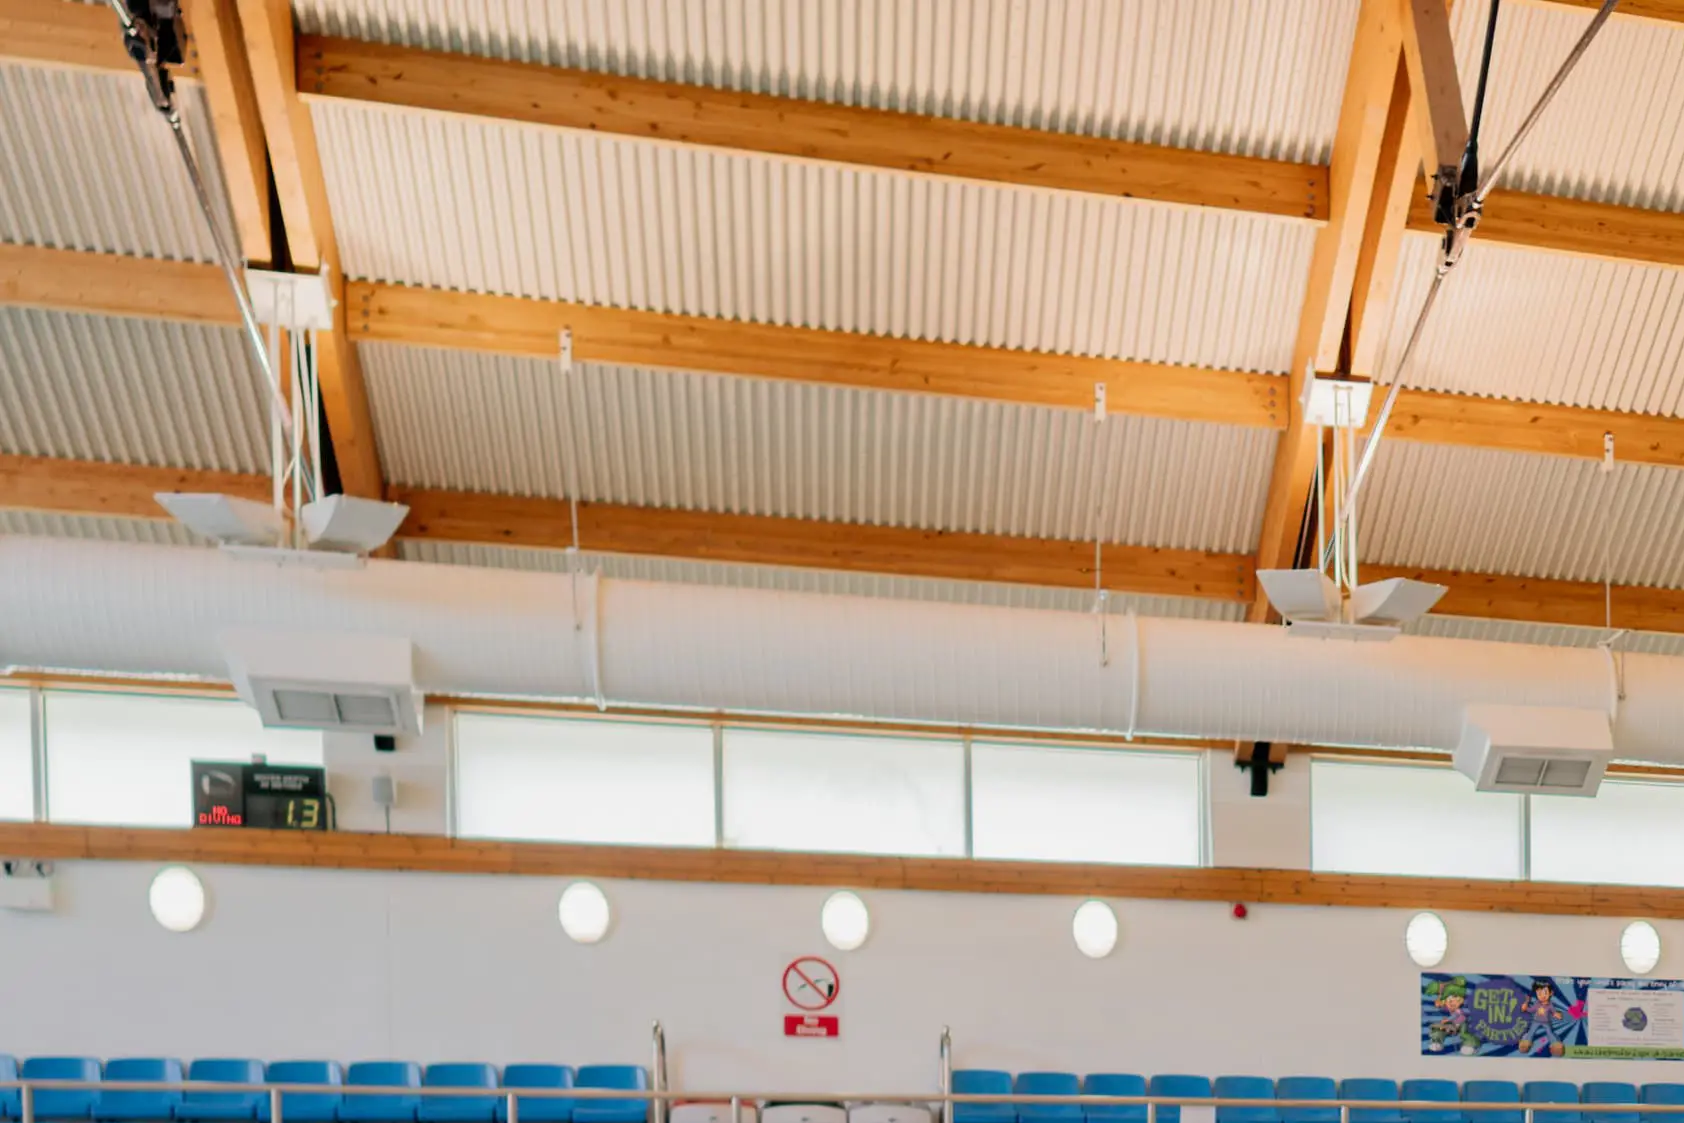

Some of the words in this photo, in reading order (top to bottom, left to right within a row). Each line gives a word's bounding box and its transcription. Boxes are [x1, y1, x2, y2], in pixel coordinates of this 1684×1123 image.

[212, 805, 228, 816] NO
[1473, 988, 1514, 1010] GET
[1488, 998, 1518, 1024] IN!
[1475, 1016, 1528, 1041] PARTIES
